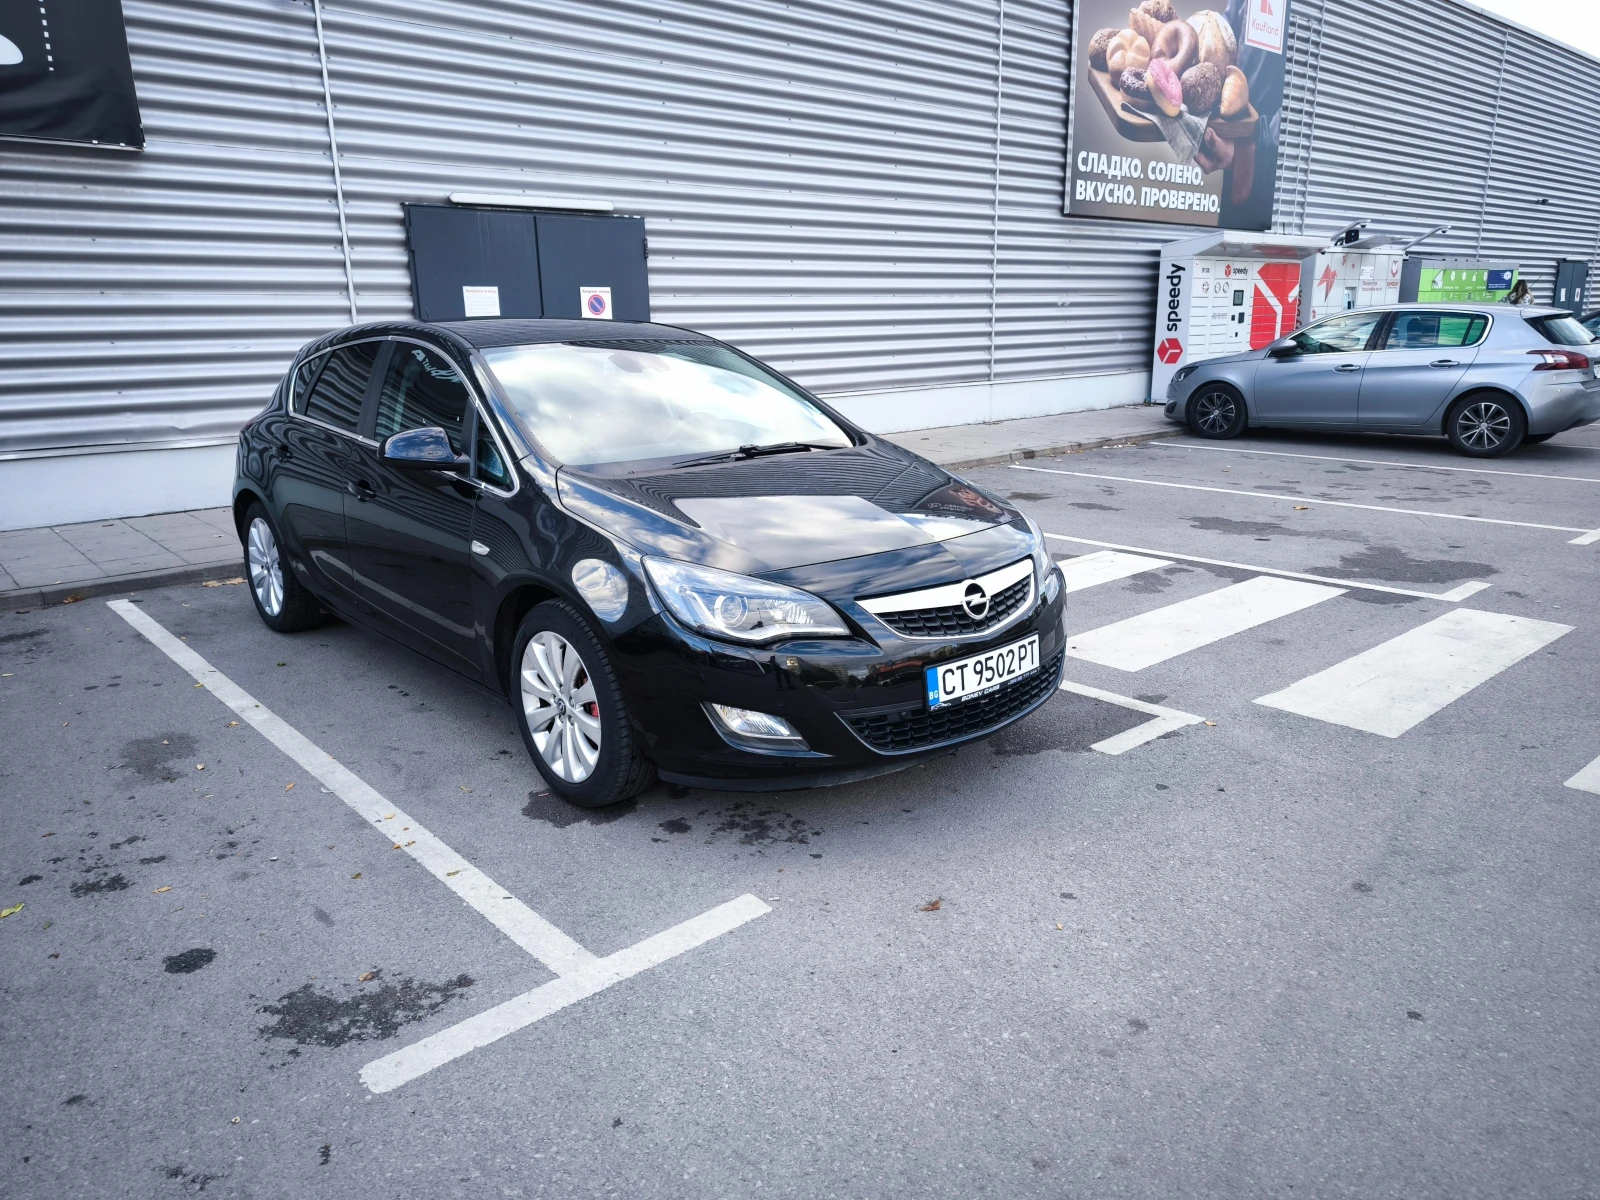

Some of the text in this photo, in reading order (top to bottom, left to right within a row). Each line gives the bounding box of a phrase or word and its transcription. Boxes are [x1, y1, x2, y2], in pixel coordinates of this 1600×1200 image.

[1252, 18, 1279, 36] Kaufland
[1077, 151, 1204, 186] СЛАДКО. СОЛЕНО.
[1075, 179, 1221, 213] ВКУСНО. ПРОВЕРЕНО.
[1232, 266, 1249, 276] speedy
[1166, 263, 1186, 332] speedy
[942, 639, 1036, 696] CT 9502 PT
[928, 690, 938, 700] BG
